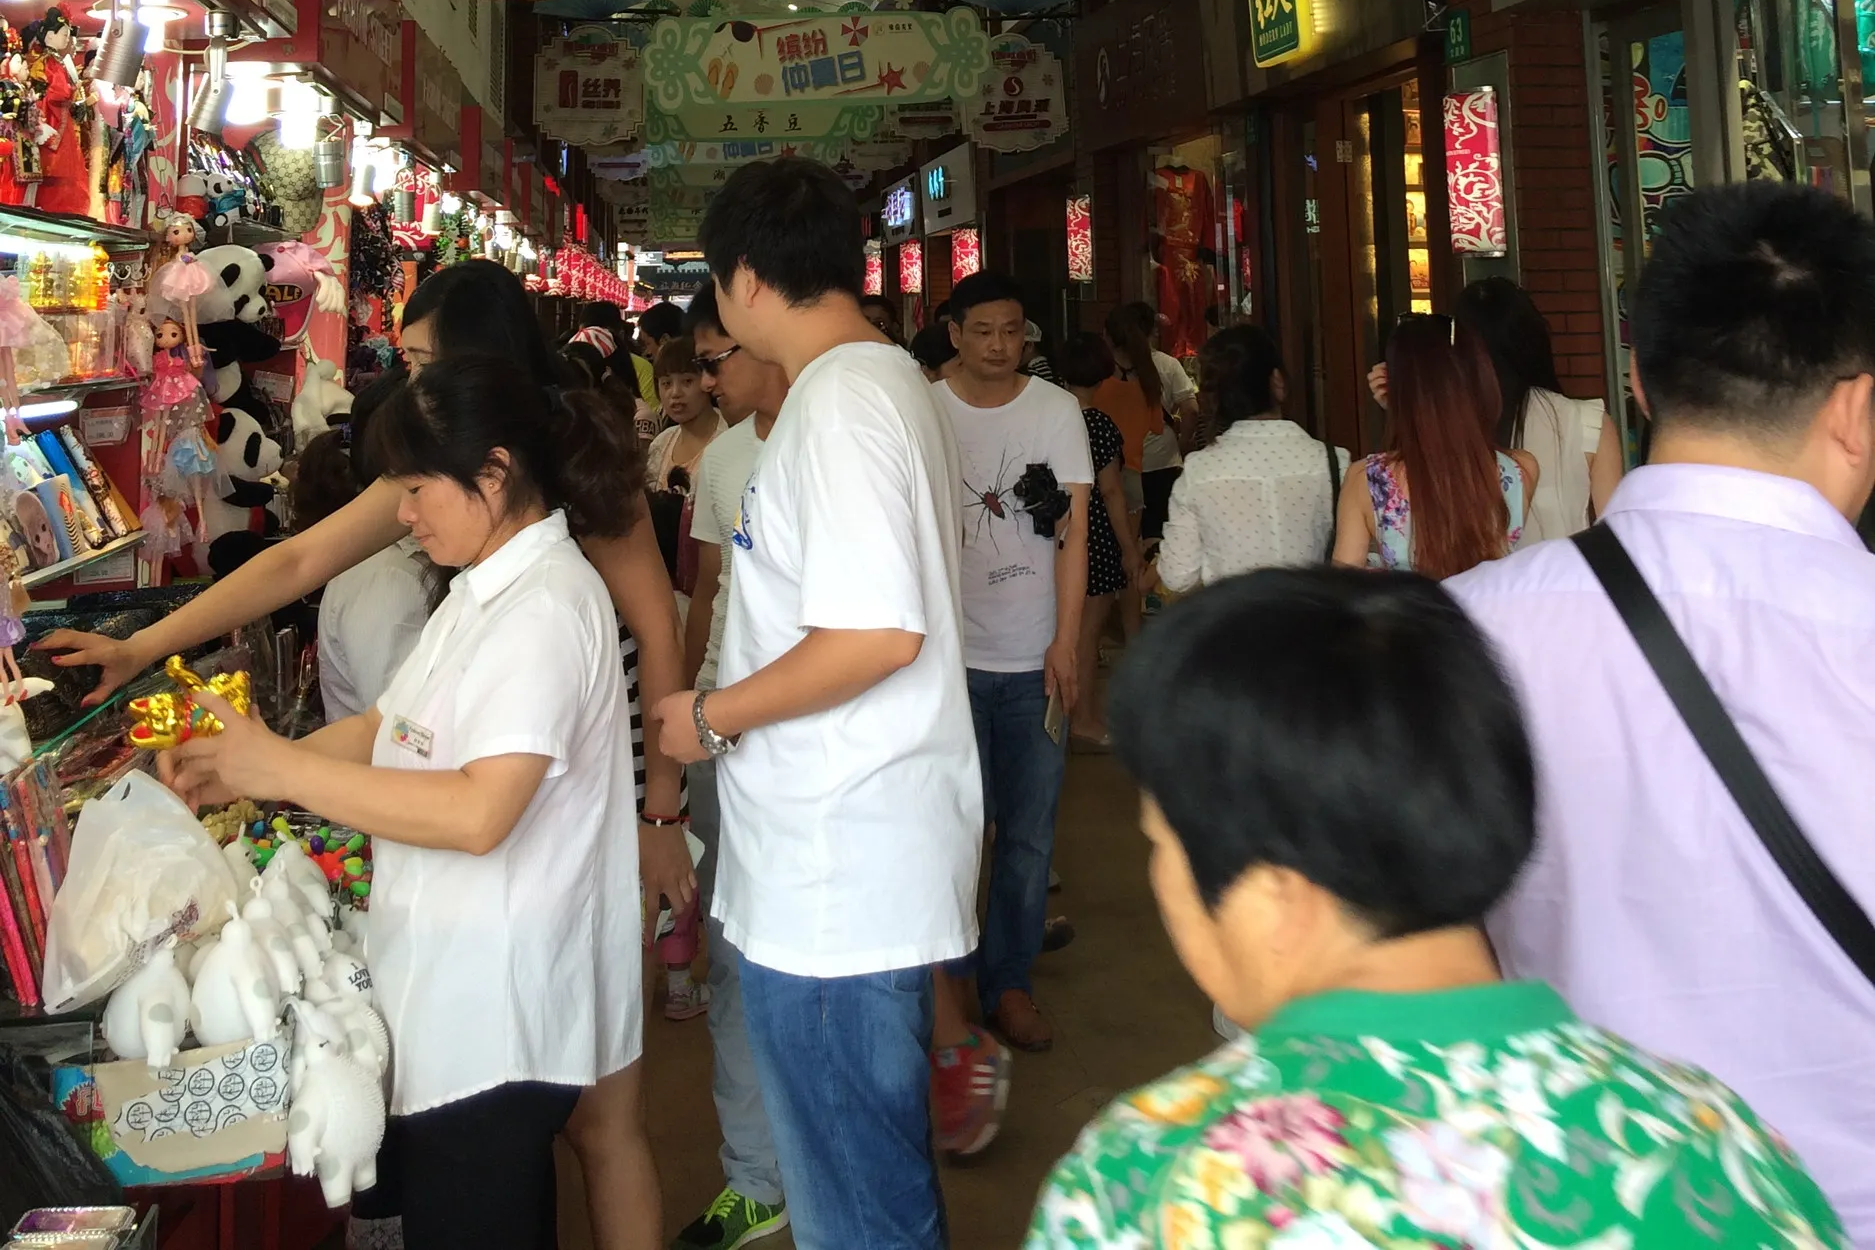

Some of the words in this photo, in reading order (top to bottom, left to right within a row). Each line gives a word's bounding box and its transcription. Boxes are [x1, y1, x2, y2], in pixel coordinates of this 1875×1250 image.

[1449, 17, 1463, 44] 63
[718, 113, 802, 134] 五香豆
